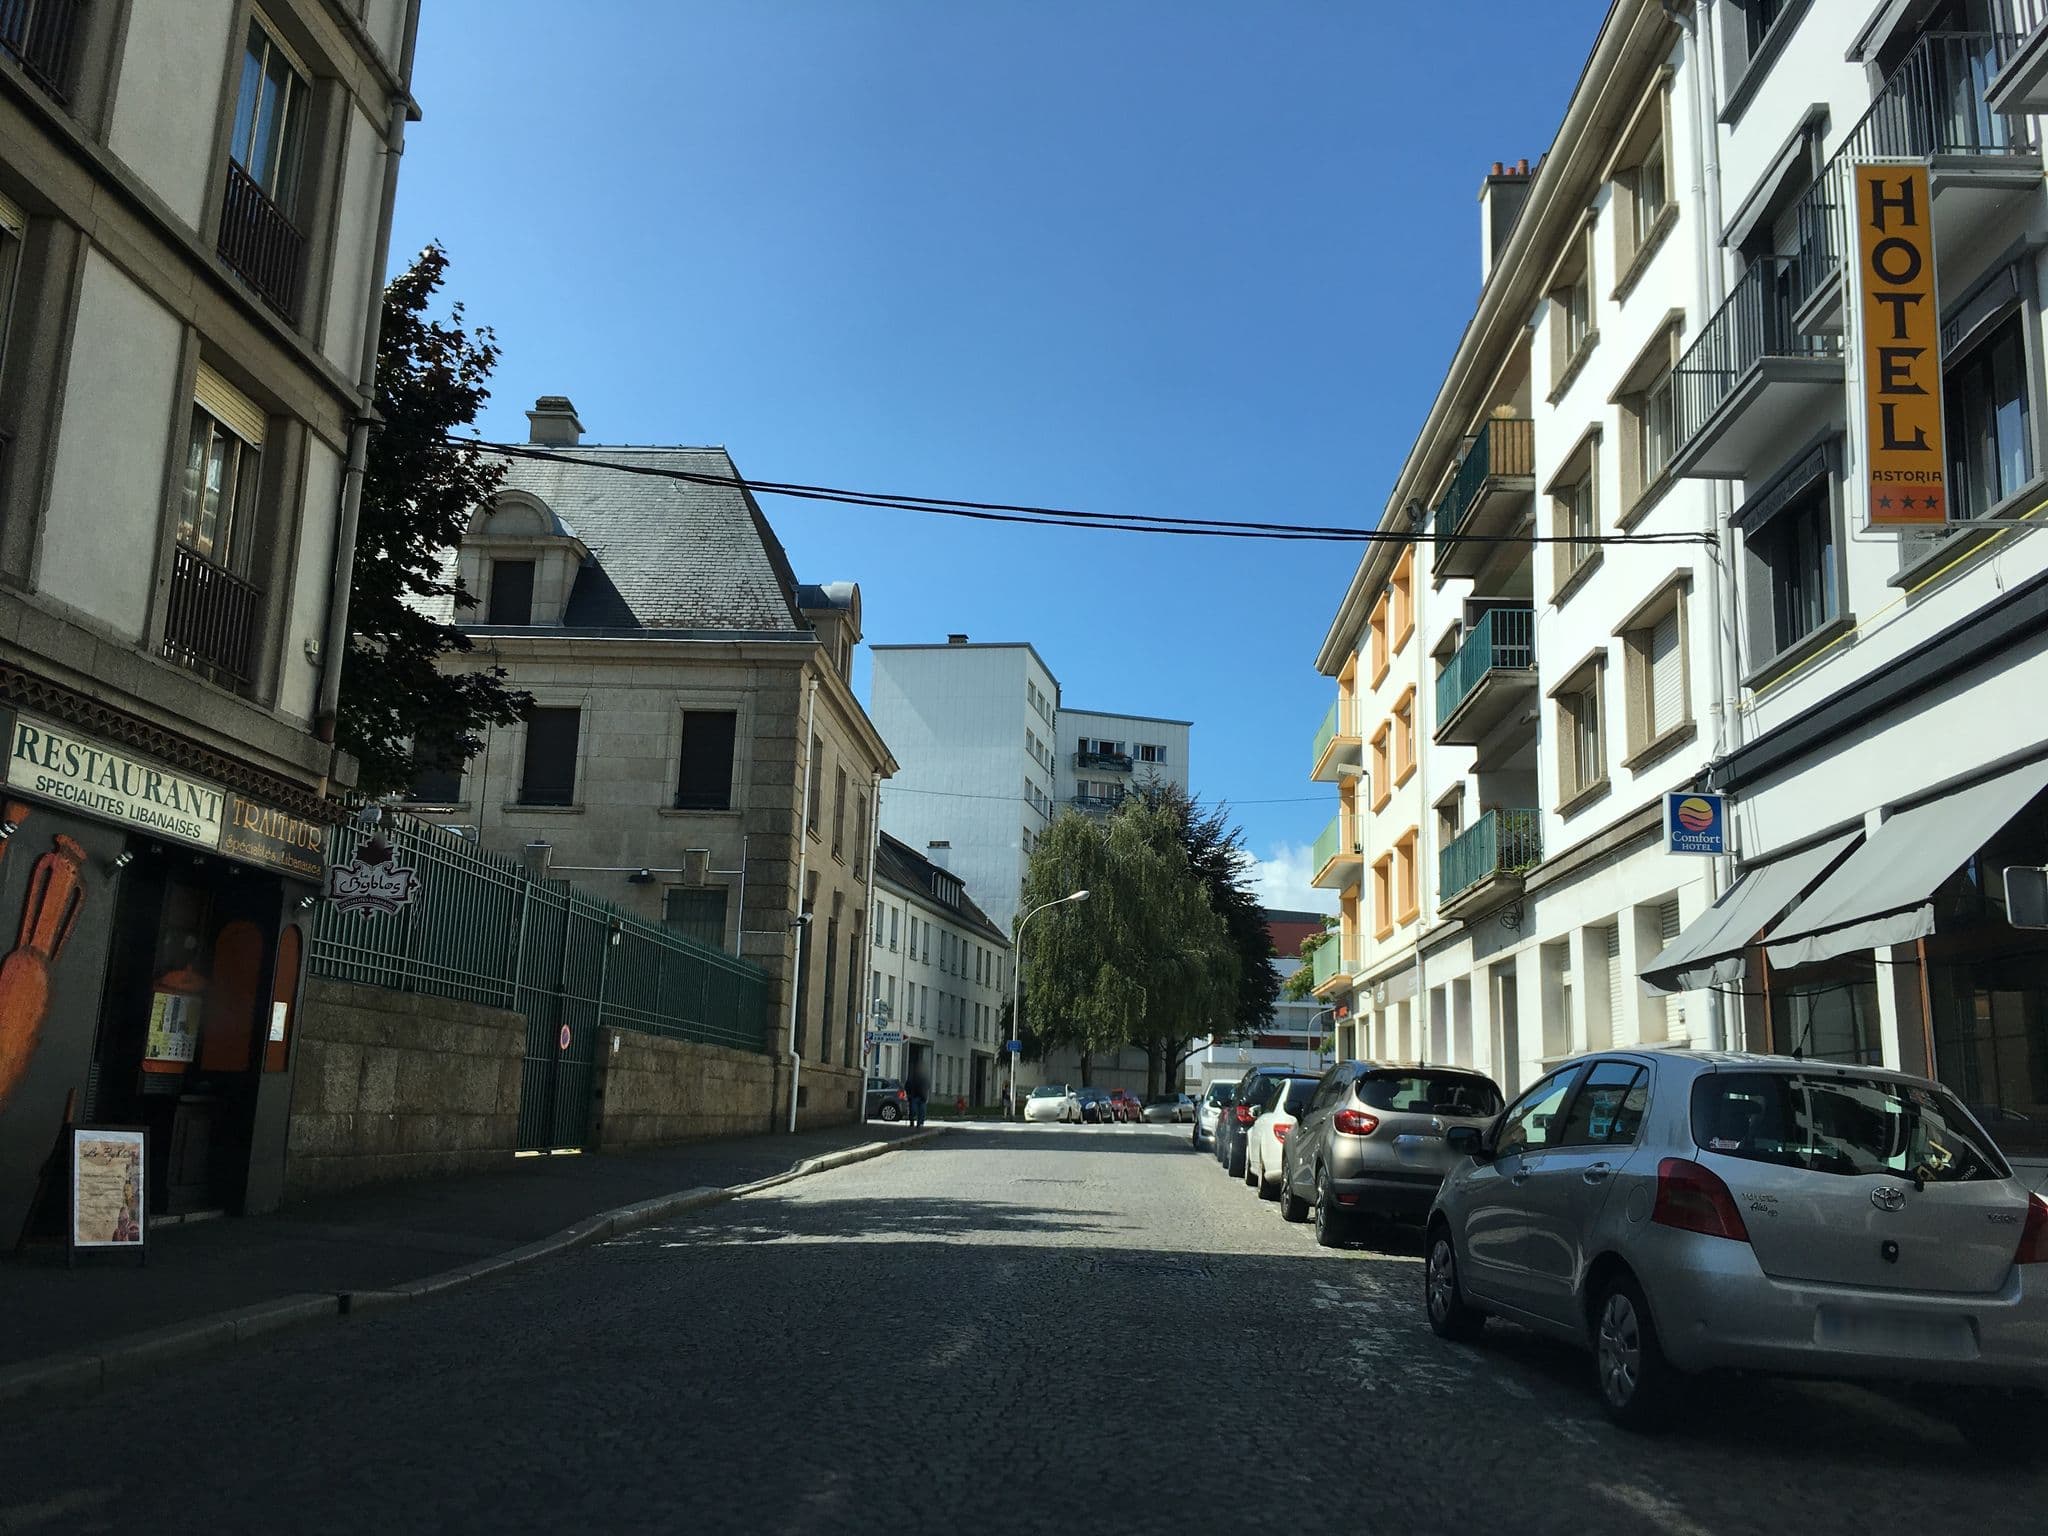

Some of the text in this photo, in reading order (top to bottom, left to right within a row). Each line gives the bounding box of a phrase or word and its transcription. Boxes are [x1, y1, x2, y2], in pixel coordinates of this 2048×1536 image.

[1868, 175, 1933, 451] HOTEL
[1872, 471, 1942, 483] ASTORIA
[13, 723, 222, 824] RESTAURANT
[36, 775, 201, 839] SPECIALITES LIBANAISES
[233, 798, 321, 853] TRAITEUR
[1672, 831, 1720, 843] Comfort
[339, 874, 401, 894] Byblos
